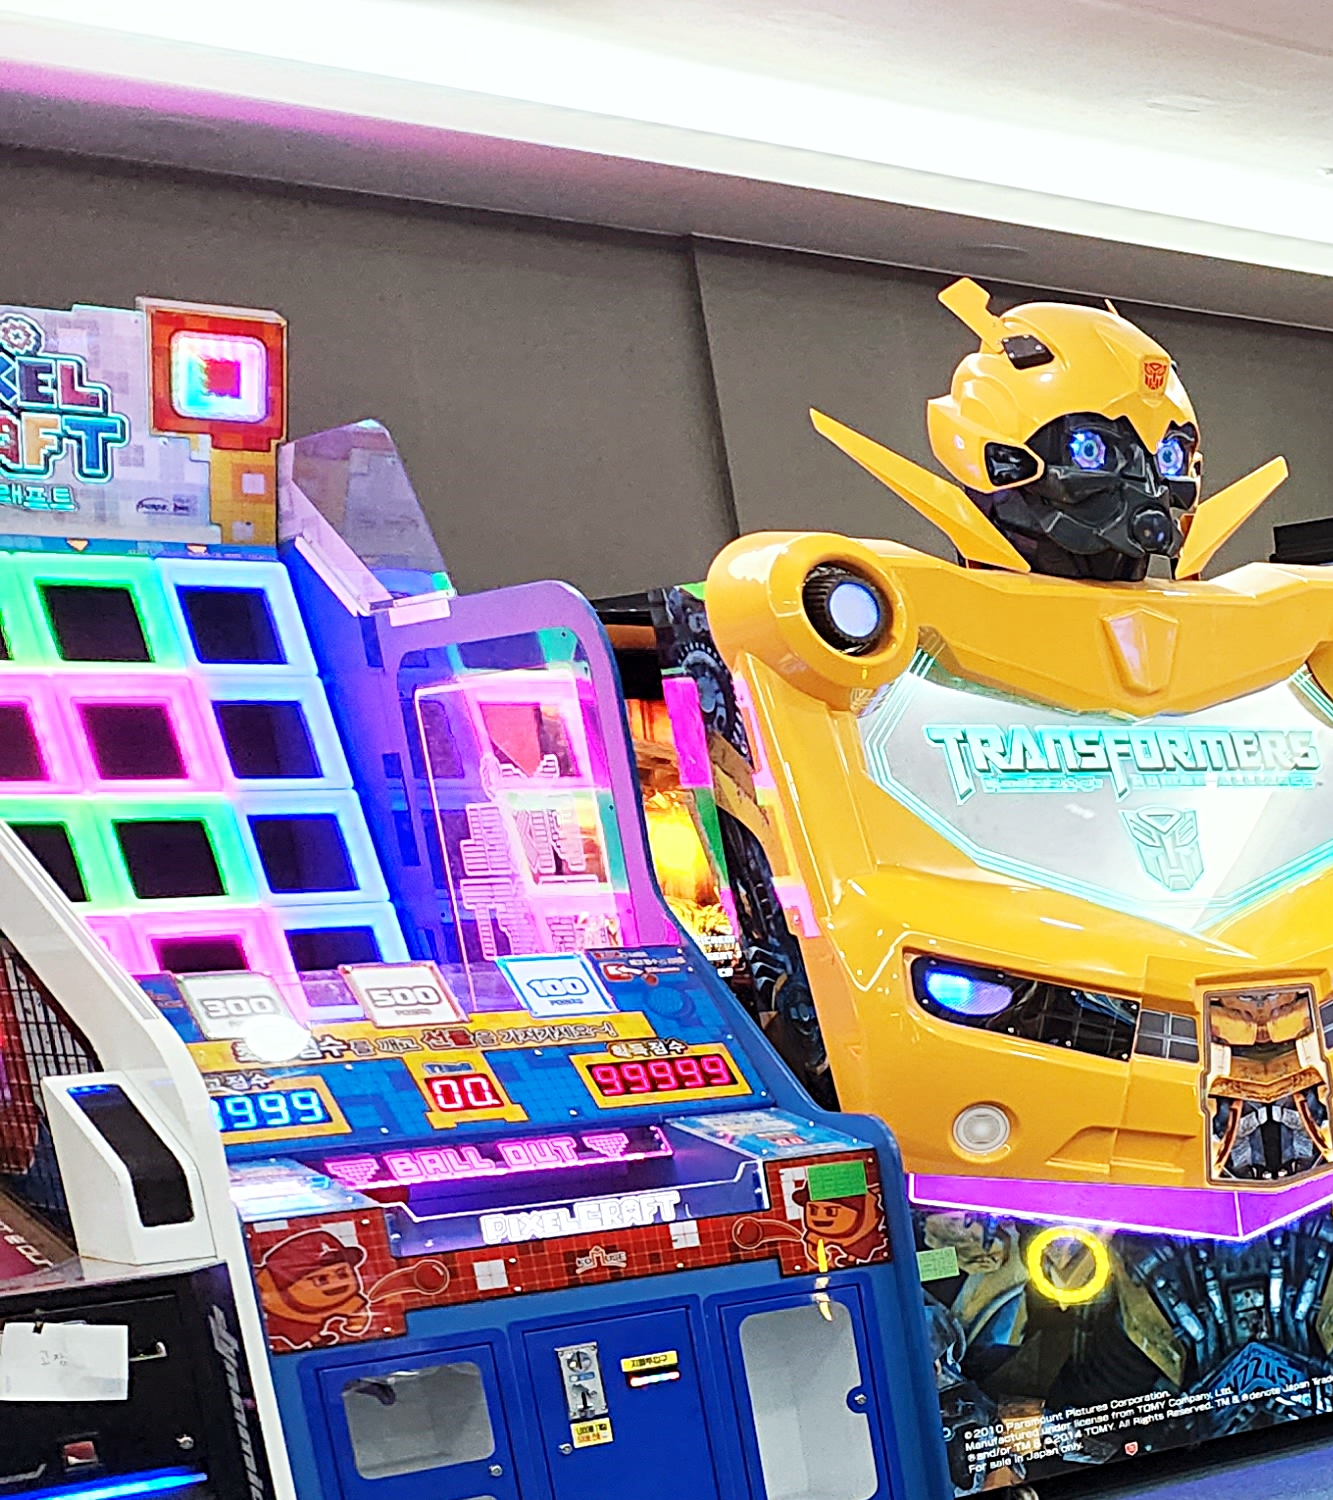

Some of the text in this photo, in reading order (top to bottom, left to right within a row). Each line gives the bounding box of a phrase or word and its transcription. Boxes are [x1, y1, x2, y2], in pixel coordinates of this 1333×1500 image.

[923, 724, 1322, 805] TRANSFORMERS
[201, 996, 281, 1020] 300
[366, 985, 441, 1009] 500
[527, 977, 590, 998] 100
[591, 1055, 733, 1097] 99999
[384, 1135, 578, 1181] BALL OUT
[480, 1190, 681, 1245] PIXELCRAFT
[965, 1430, 1039, 1452] Manufactured
[1040, 1421, 1072, 1436] under
[1073, 1415, 1109, 1430] license
[1111, 1409, 1135, 1422] from
[1136, 1399, 1167, 1414] TOMY
[1006, 1412, 1064, 1434] Paramount
[1065, 1403, 1109, 1420] Pictures
[1110, 1389, 1172, 1410] Corporation.
[1118, 1418, 1132, 1430] All
[1133, 1412, 1164, 1428] Rights
[1167, 1403, 1215, 1418] Reserved.
[1282, 1379, 1310, 1393] Japan
[968, 1462, 988, 1475] For
[989, 1457, 1012, 1470] sale
[1014, 1454, 1024, 1464] in
[1026, 1448, 1059, 1463] Japan
